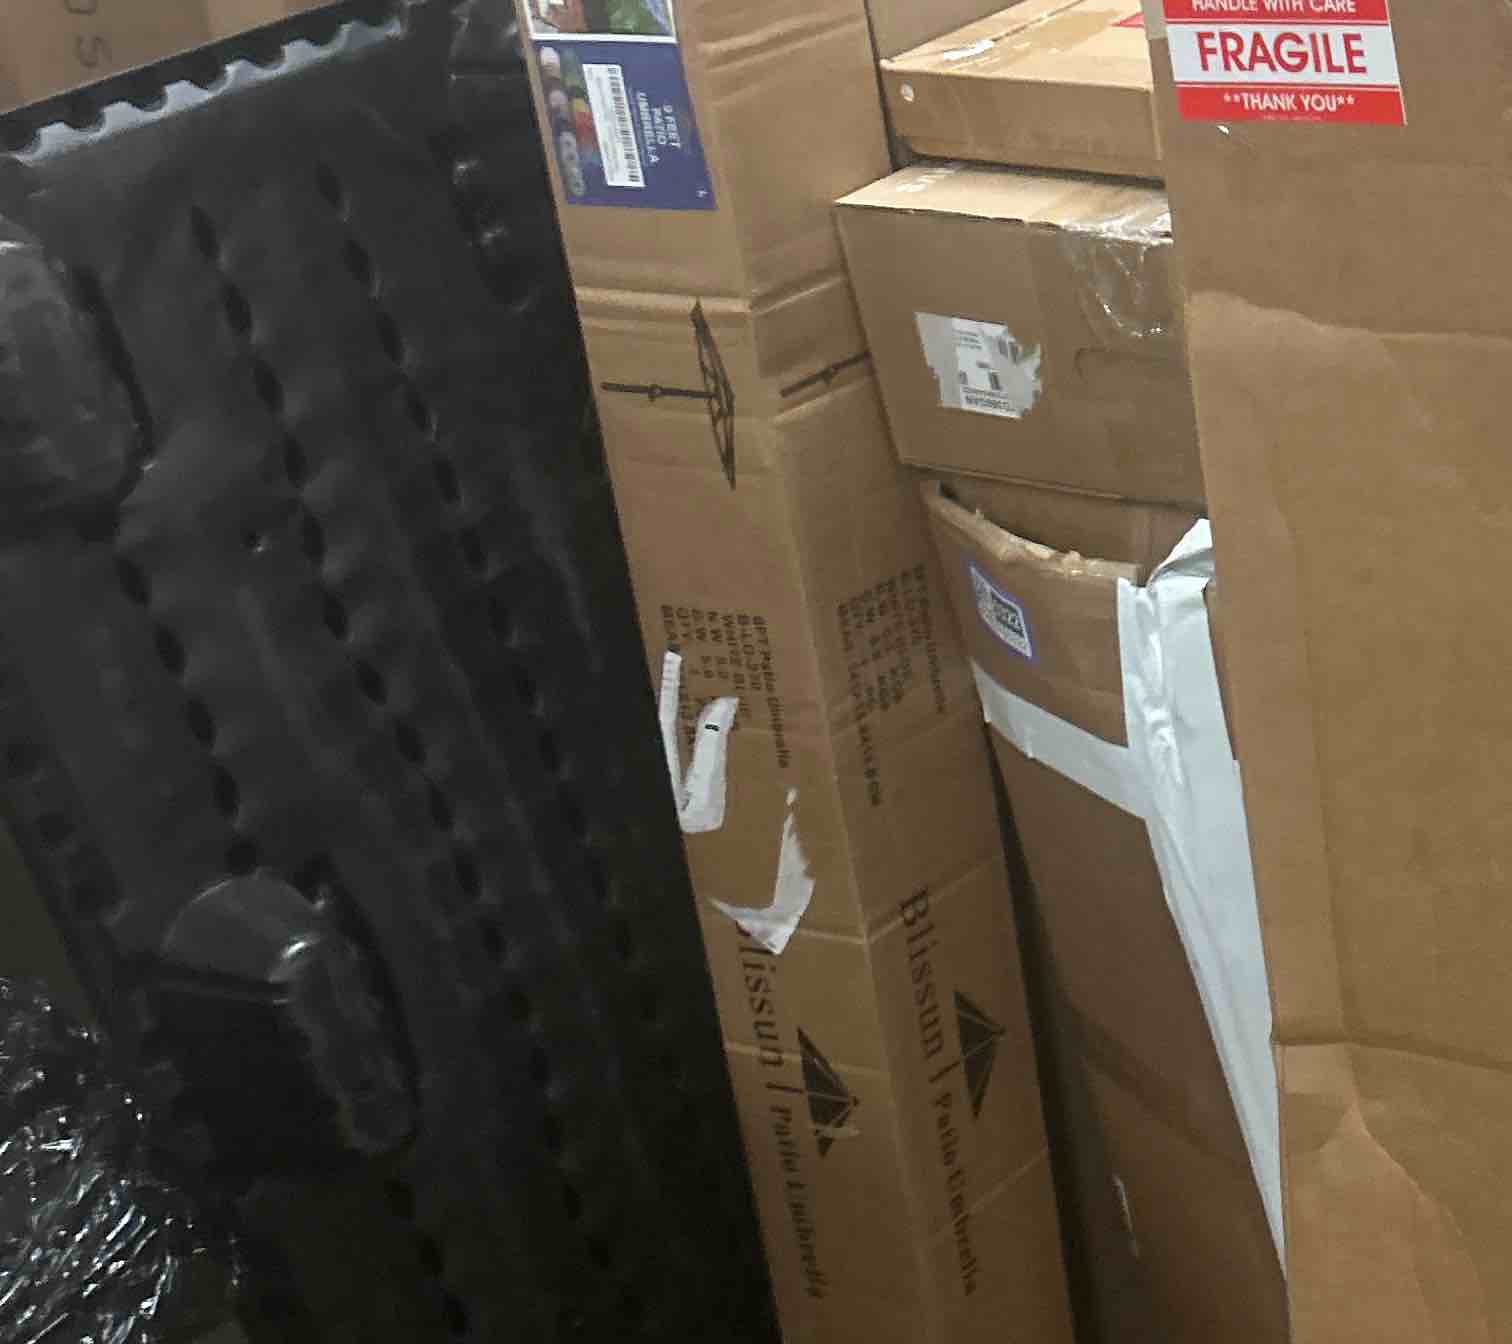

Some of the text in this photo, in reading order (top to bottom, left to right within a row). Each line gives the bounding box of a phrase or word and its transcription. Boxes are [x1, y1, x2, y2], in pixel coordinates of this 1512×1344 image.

[1196, 30, 1367, 74] FRAGILE
[735, 920, 786, 1068] lissun
[900, 887, 946, 1059] Blissun
